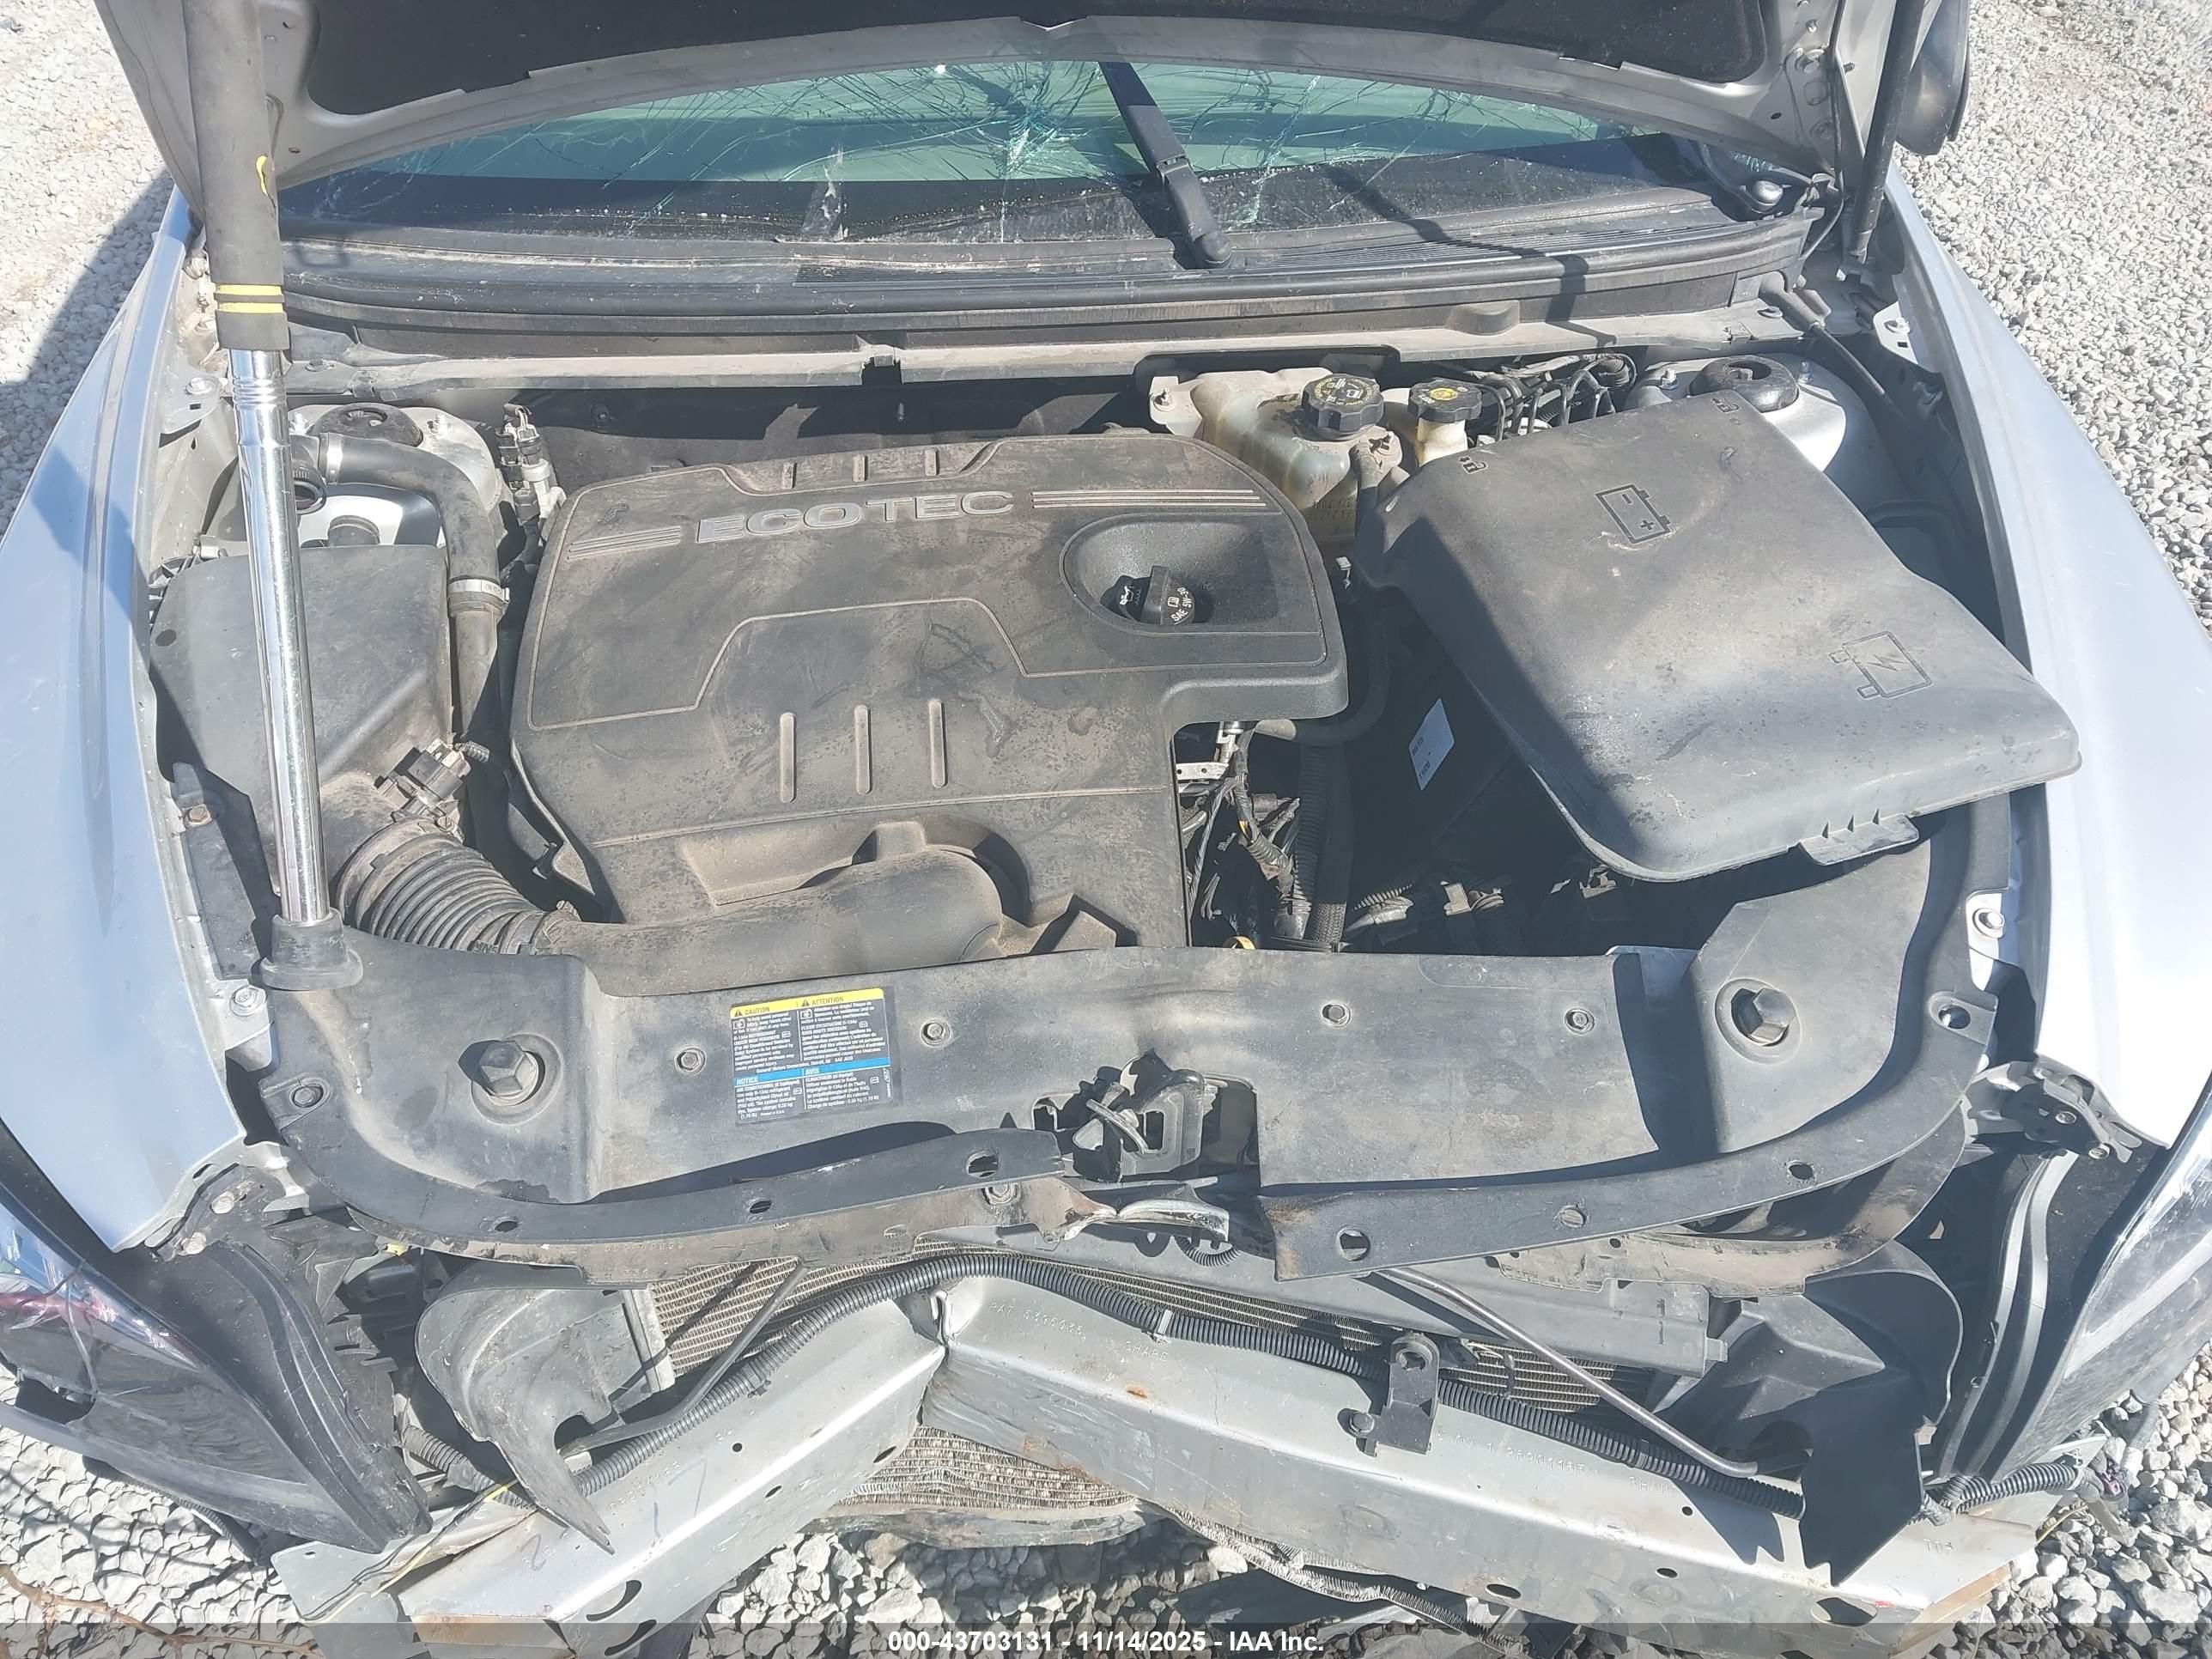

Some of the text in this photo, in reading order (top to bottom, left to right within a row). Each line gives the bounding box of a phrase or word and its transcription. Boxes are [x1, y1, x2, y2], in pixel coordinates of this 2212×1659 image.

[696, 490, 1014, 544] ECOTEC
[1170, 586, 1192, 621] SAE 5W-30
[811, 996, 844, 1006] ATTENTION
[744, 1006, 770, 1016] CAUTION
[805, 1067, 820, 1076] AVIS
[736, 1075, 757, 1085] NOTICE
